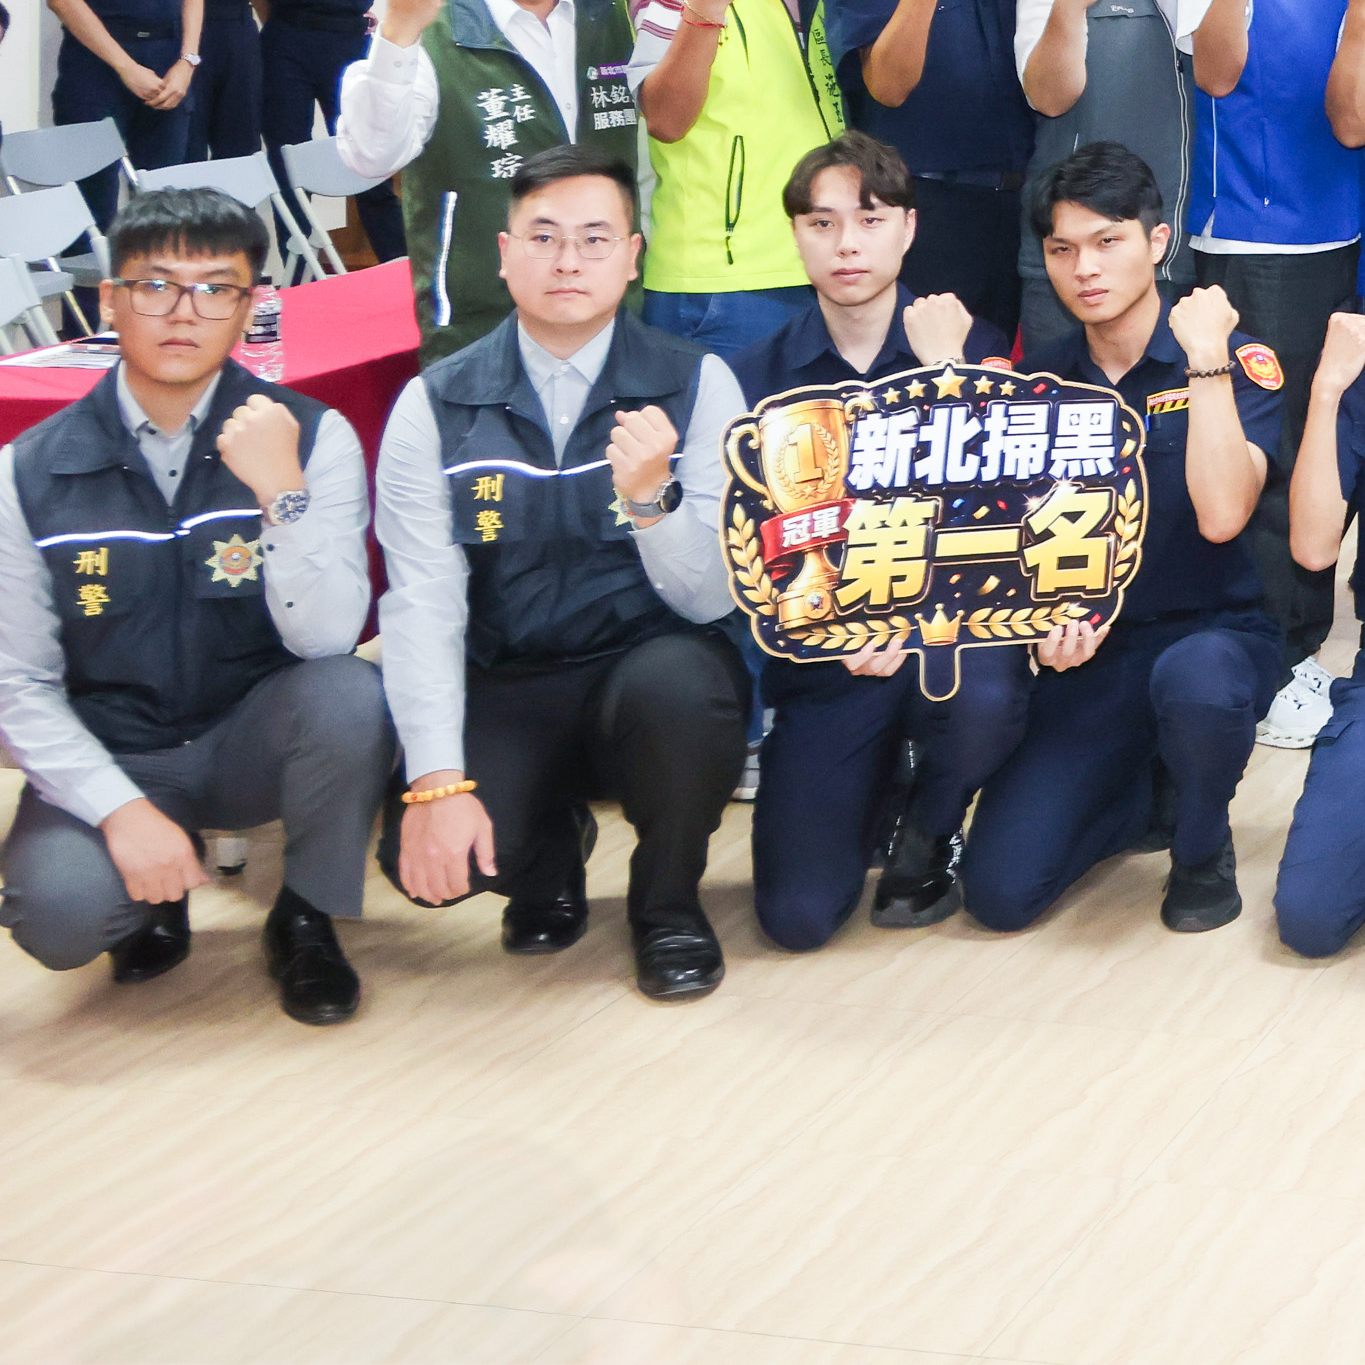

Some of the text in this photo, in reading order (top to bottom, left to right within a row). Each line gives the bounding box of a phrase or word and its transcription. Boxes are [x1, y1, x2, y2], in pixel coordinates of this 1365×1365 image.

[510, 83, 536, 123] 主任
[591, 84, 636, 109] 林銘
[848, 402, 1116, 491] 新北掃黑
[471, 473, 504, 542] 刑警
[781, 506, 841, 548] 冠軍
[835, 484, 1112, 606] 第一名
[73, 547, 111, 617] 刑警
